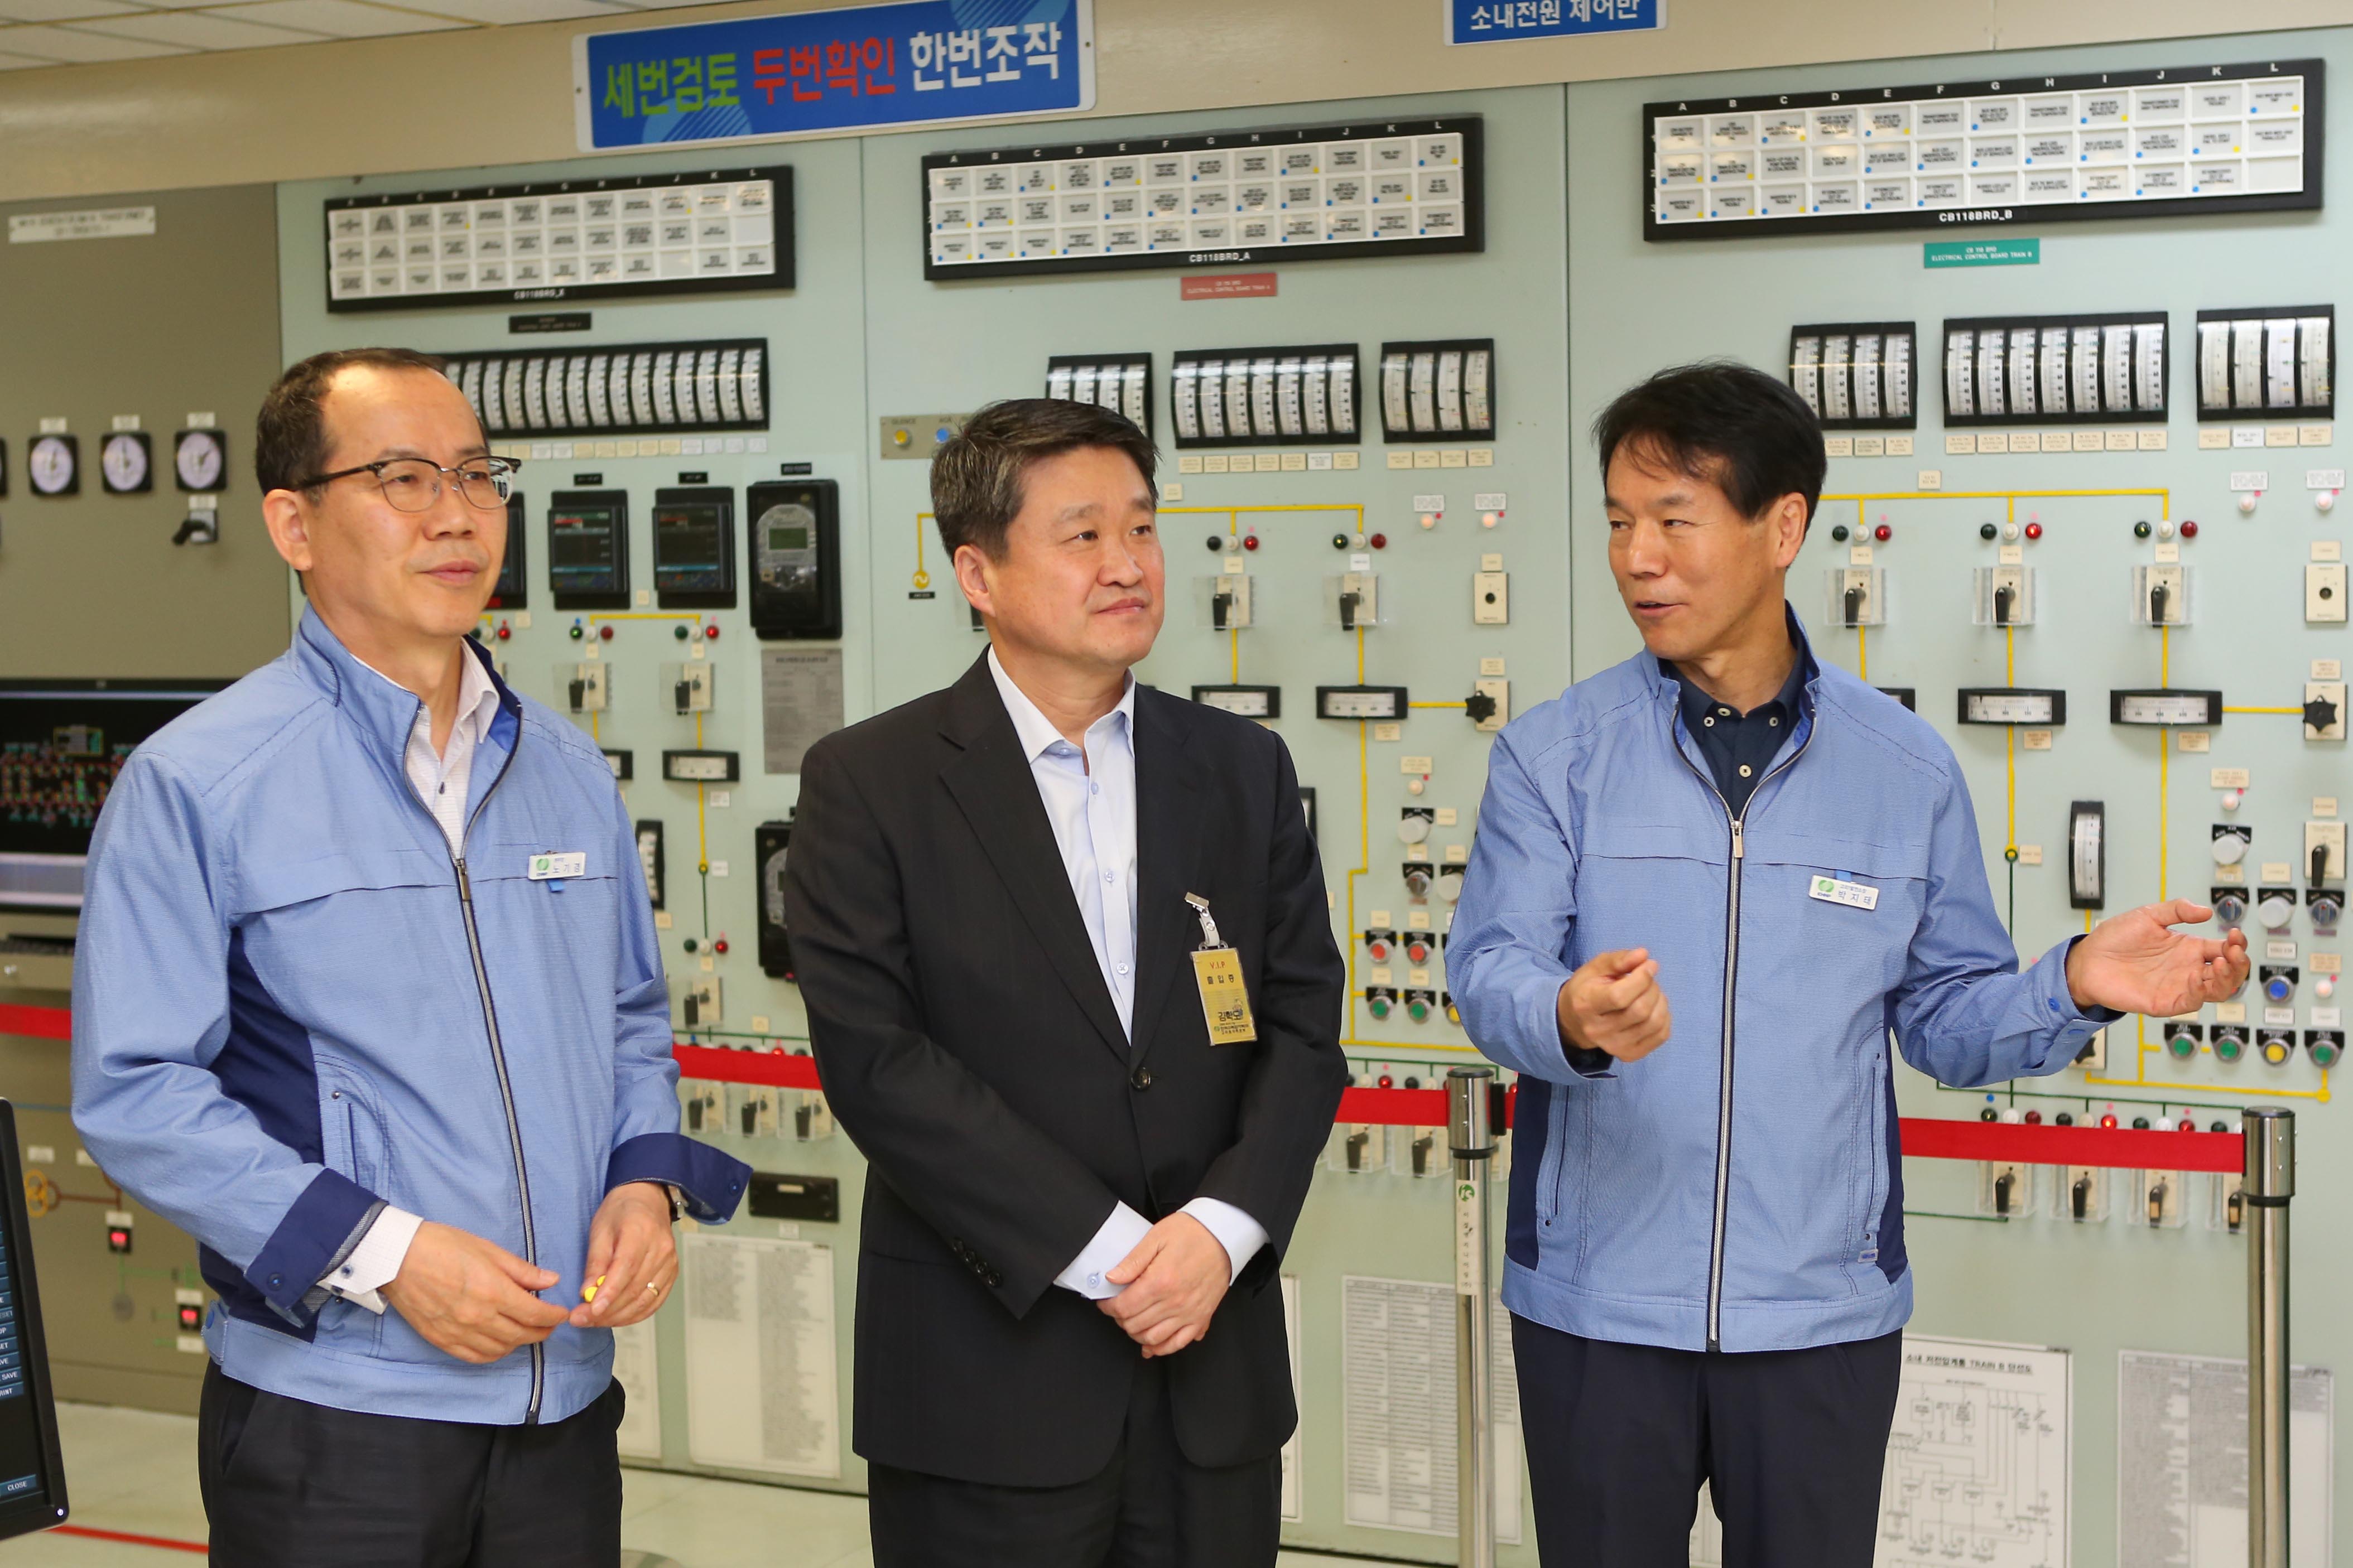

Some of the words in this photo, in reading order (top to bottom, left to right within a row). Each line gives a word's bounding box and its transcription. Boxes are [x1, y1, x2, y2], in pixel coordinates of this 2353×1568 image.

[1470, 0, 1561, 30] 소내전원
[604, 53, 740, 118] 세번검토
[753, 37, 896, 105] 두번확인
[910, 22, 1062, 91] 한번조작
[1729, 99, 1737, 108] B
[1780, 96, 1788, 104] C
[1831, 92, 1840, 101] D
[1884, 89, 1892, 98] E
[1937, 85, 1944, 94] F
[1991, 81, 2000, 90] G
[2046, 78, 2054, 86] H
[2102, 74, 2107, 83] I
[2157, 70, 2165, 80] J
[2212, 66, 2221, 76] K
[2270, 62, 2279, 72] L
[1119, 143, 1125, 151] E
[1298, 131, 1302, 139] I
[1342, 127, 1349, 136] J
[1435, 121, 1442, 129] L
[1939, 210, 2013, 222] CB118BRD_B
[1188, 252, 1251, 262] CB118BRD_A
[1970, 1359, 1995, 1369] TRAIN
[2, 1371, 18, 1381] SAVE
[7, 1481, 27, 1491] CLOSE
